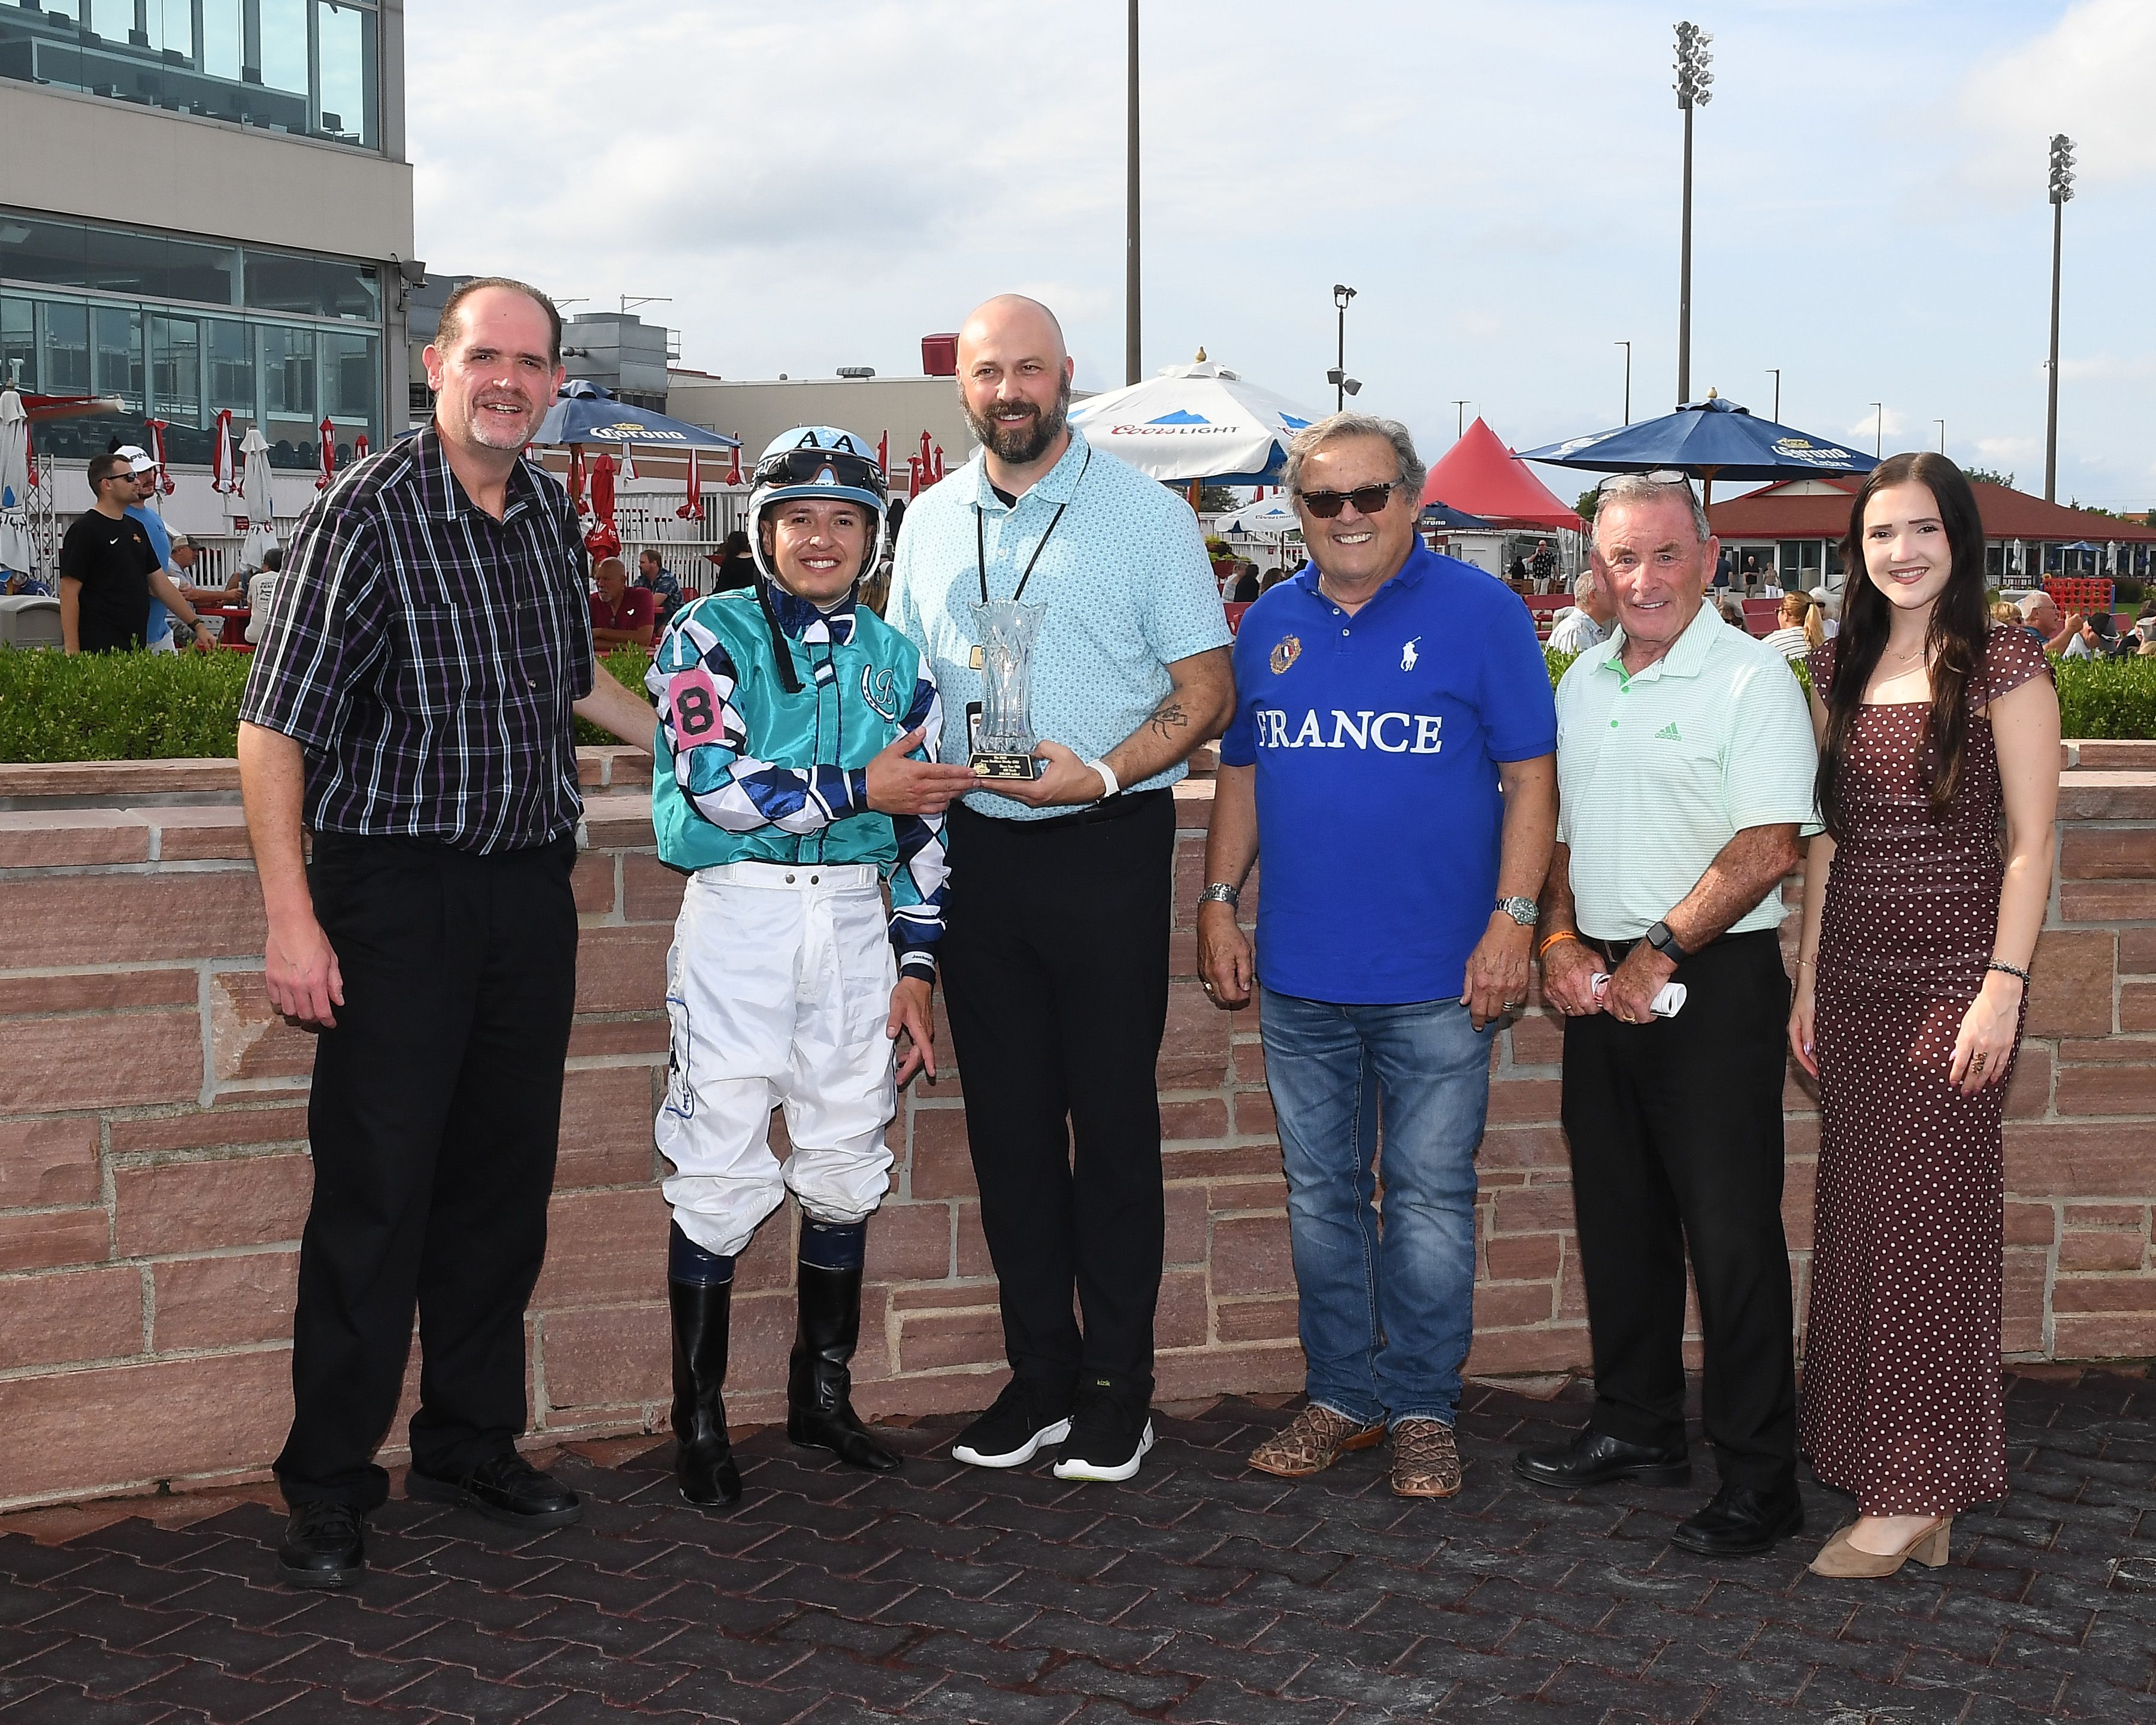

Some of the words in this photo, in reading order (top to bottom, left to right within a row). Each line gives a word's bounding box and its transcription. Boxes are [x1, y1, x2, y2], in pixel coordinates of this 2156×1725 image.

[590, 428, 687, 440] Corona
[1111, 425, 1176, 435] Coors
[129, 452, 147, 463] PIN
[1771, 445, 1851, 459] Corona
[676, 685, 714, 736] 8
[1255, 709, 1442, 753] FRANCE
